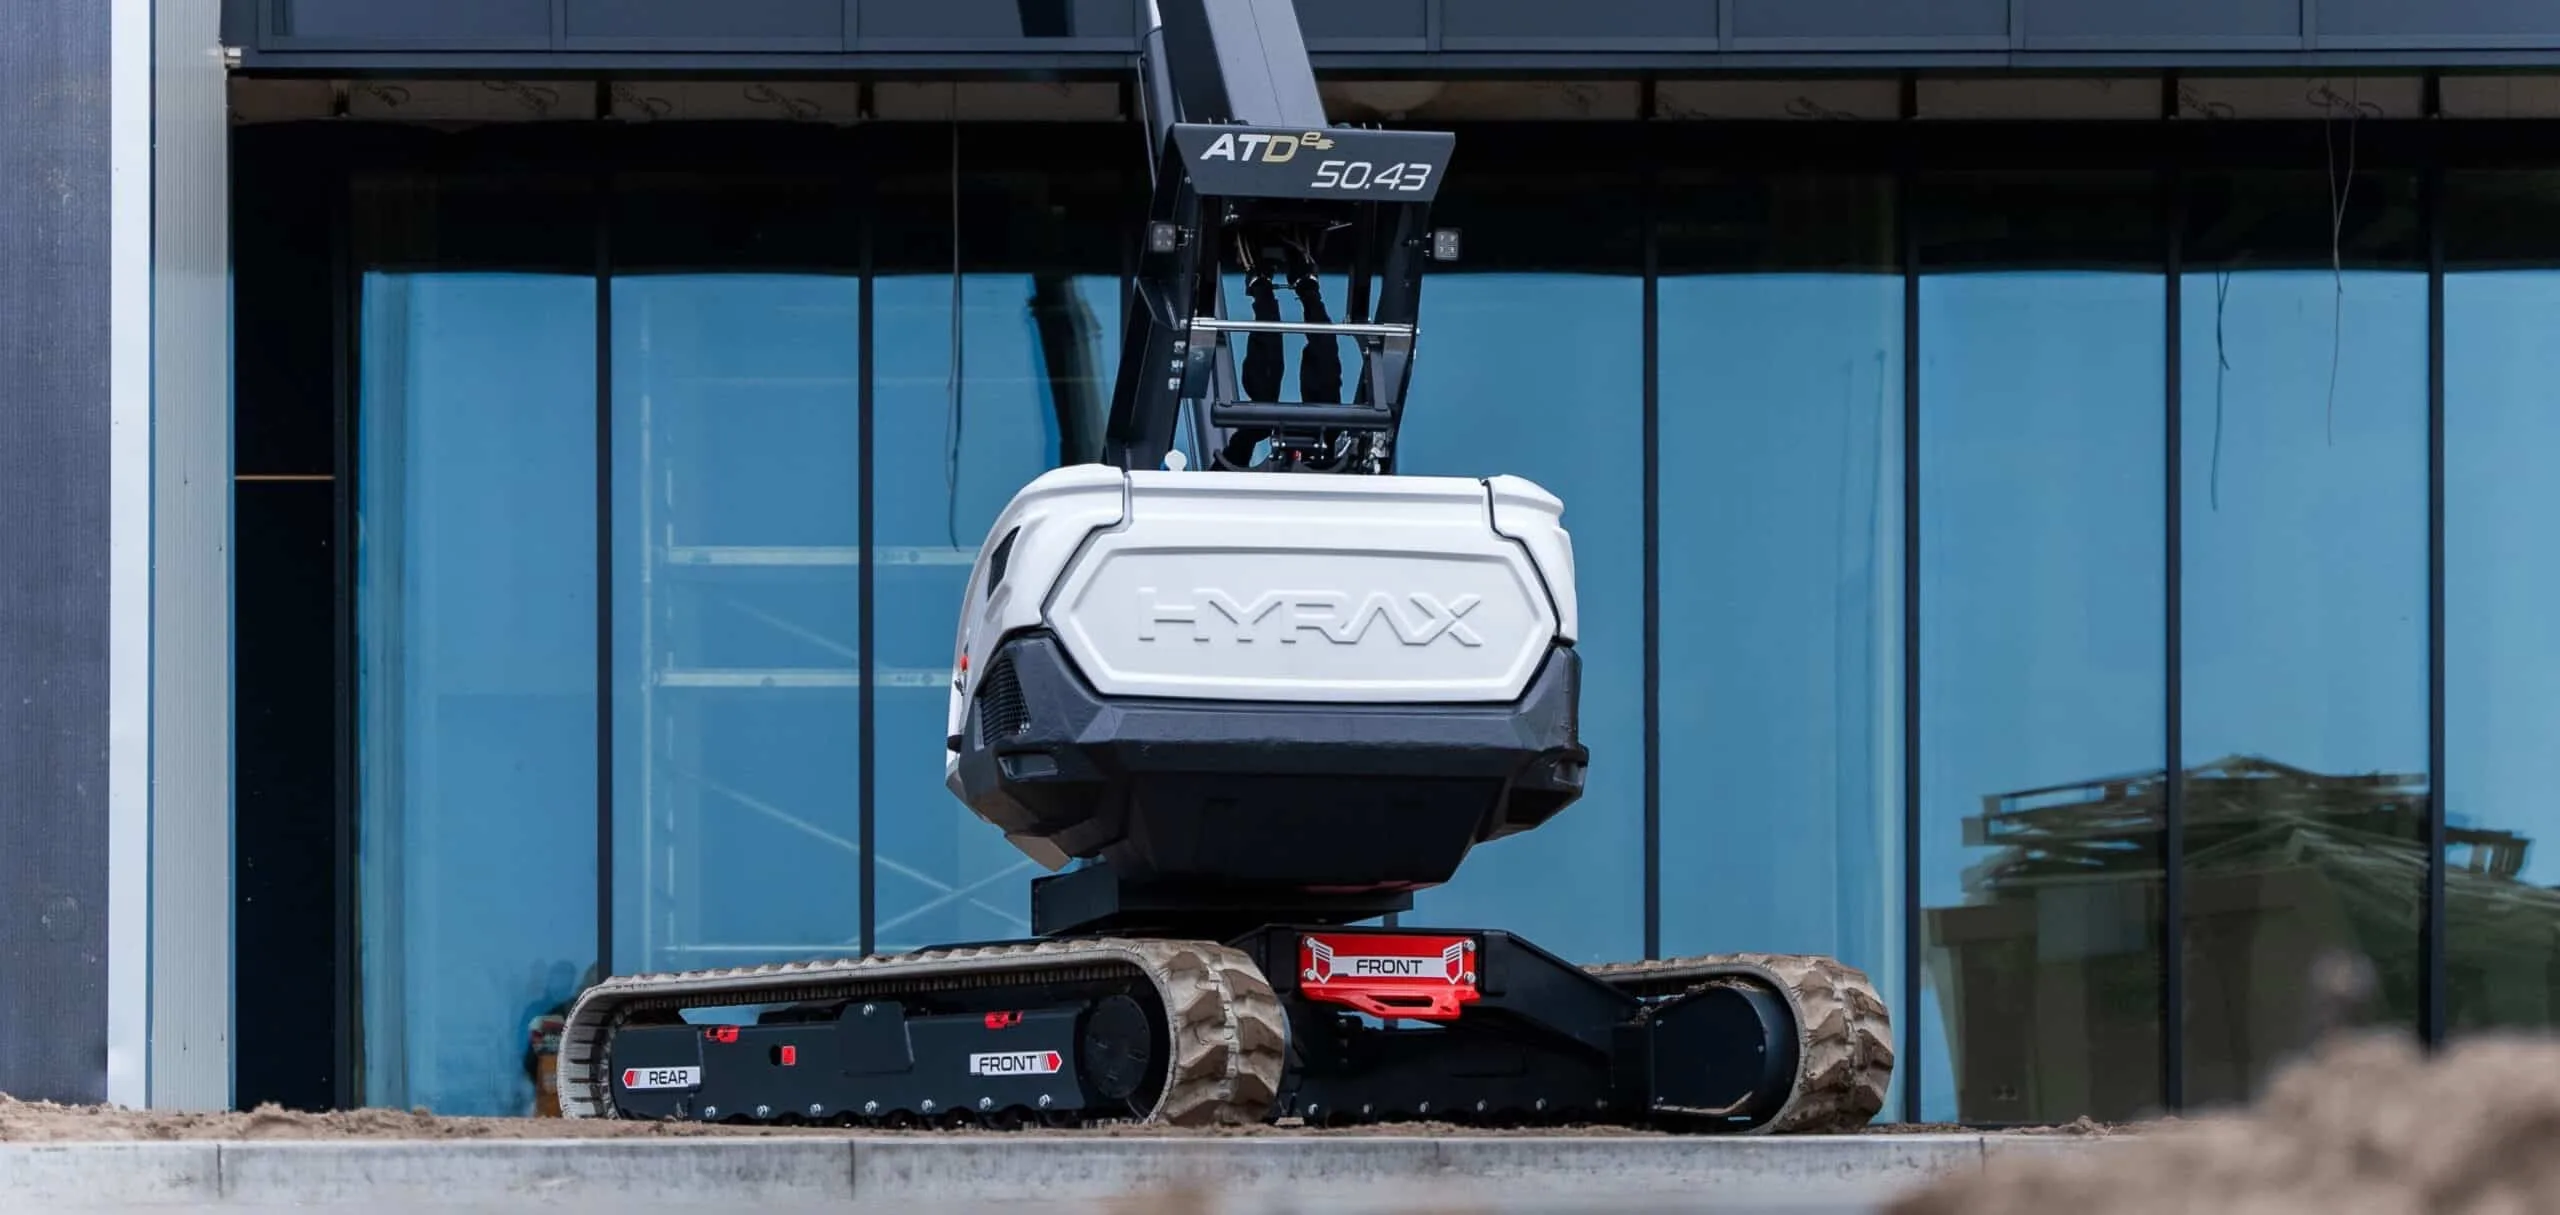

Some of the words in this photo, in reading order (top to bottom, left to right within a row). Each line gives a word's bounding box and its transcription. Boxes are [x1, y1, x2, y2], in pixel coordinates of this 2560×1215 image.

[1311, 160, 1433, 192] 50.43
[1138, 586, 1483, 647] HYRAX
[1356, 958, 1423, 975] FRONT
[979, 1054, 1037, 1072] FRONT
[649, 1069, 689, 1085] REAR
